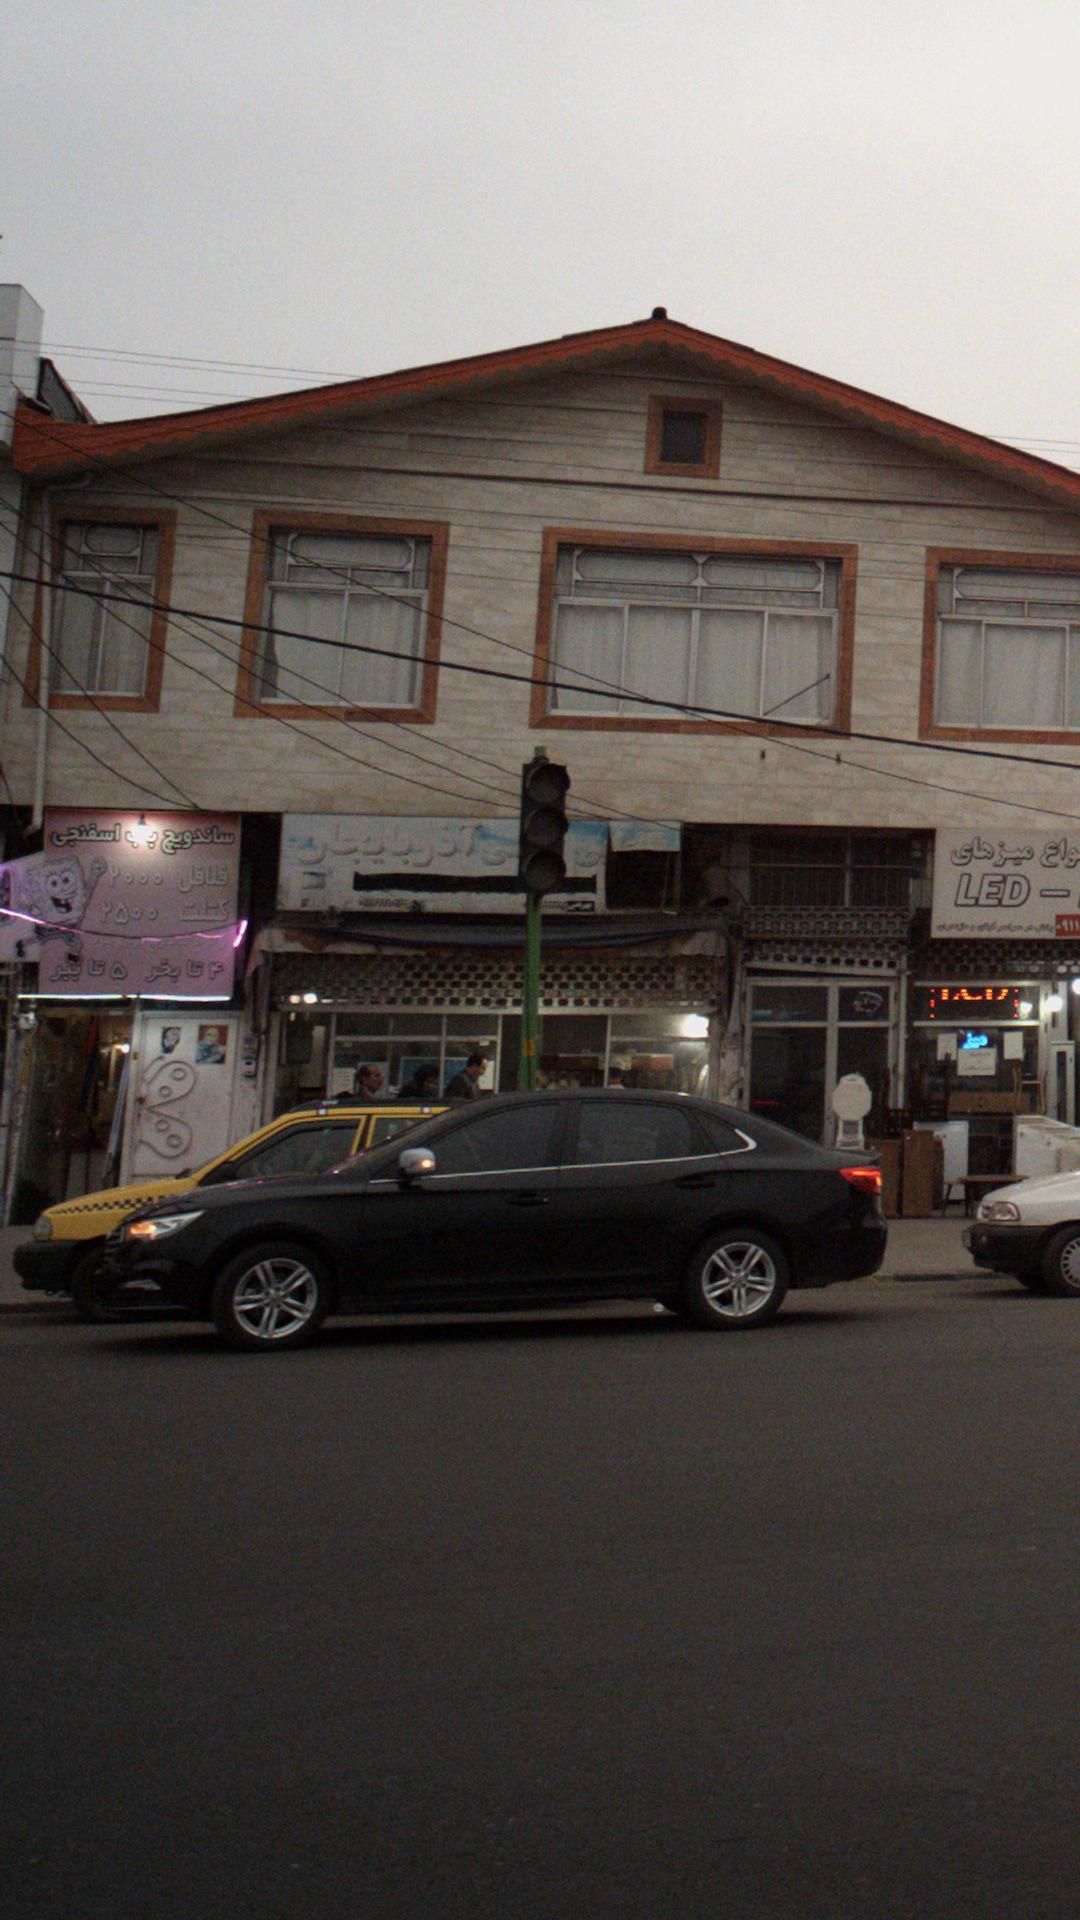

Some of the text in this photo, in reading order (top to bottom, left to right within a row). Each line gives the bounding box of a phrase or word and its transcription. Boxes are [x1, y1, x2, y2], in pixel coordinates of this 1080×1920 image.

[52, 822, 122, 847] اسفنجی
[160, 825, 235, 854] ساندویچ
[1040, 838, 1080, 869] واع
[954, 872, 1031, 908] LED
